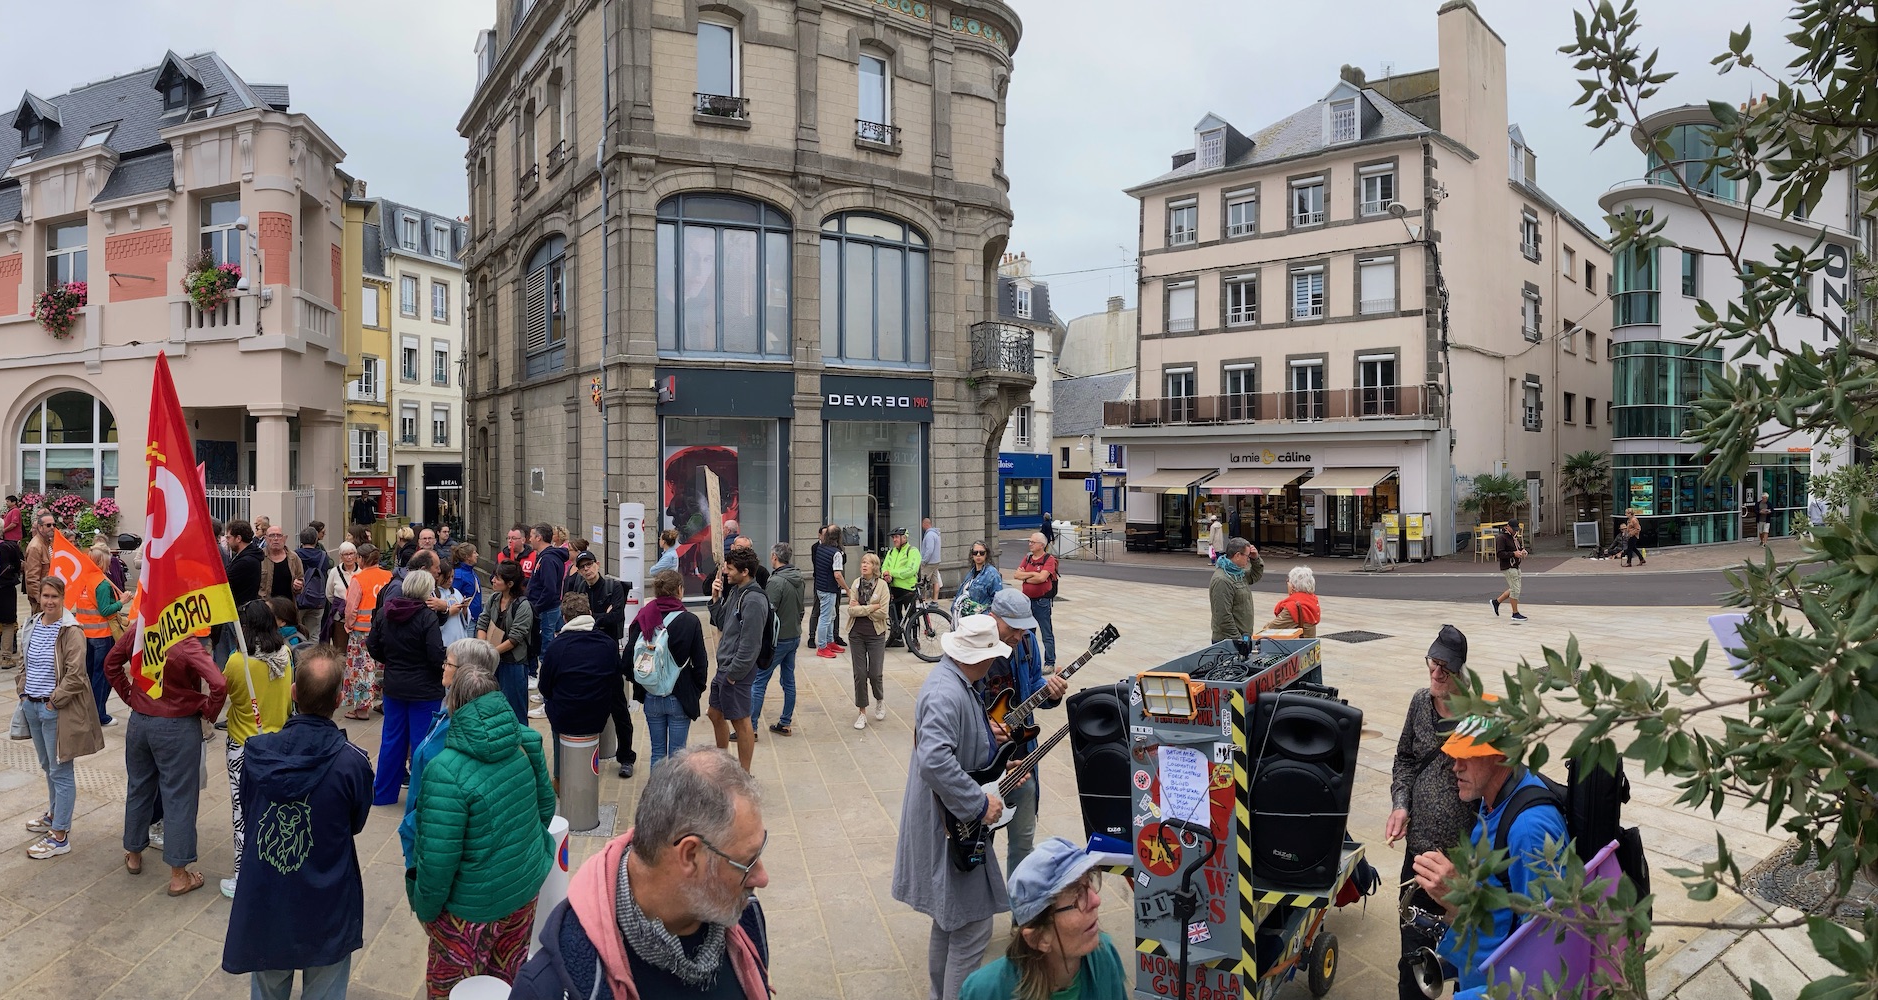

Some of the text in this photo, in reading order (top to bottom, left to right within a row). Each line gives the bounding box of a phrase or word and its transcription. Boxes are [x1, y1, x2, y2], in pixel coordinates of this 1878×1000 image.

[828, 394, 929, 408] DEVRED 1902
[1230, 451, 1312, 463] la mie câline
[522, 560, 533, 570] FO
[1148, 834, 1172, 850] THE
[1140, 847, 1181, 866] CLASH
[1140, 953, 1180, 980] NON
[1218, 973, 1241, 996] LA
[1152, 975, 1239, 1000] GUERR
